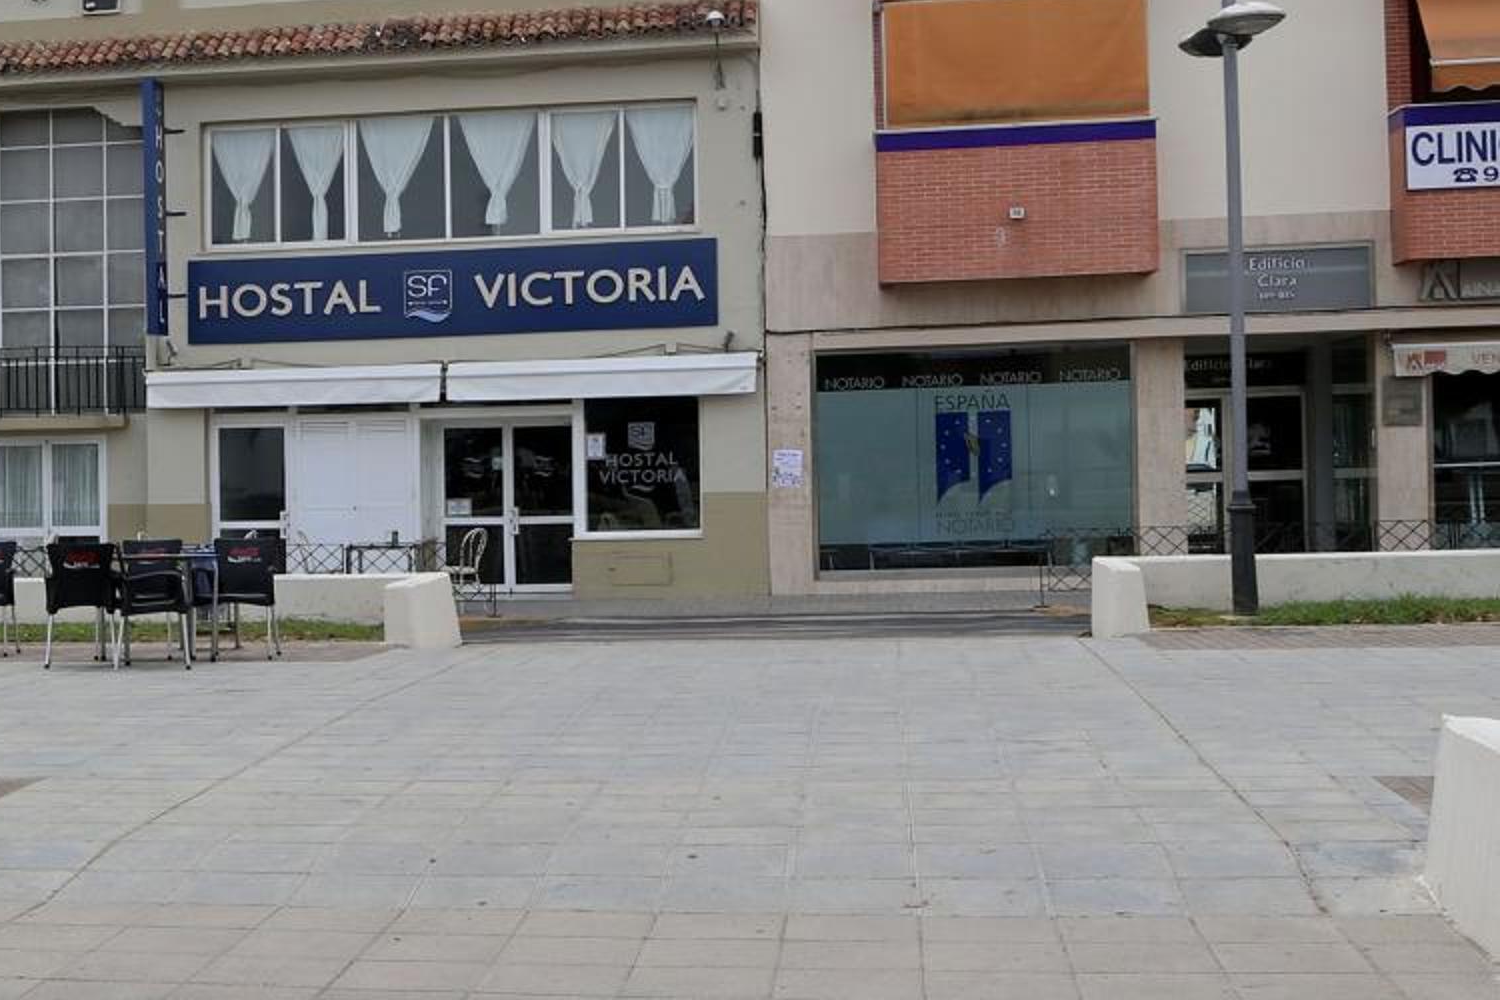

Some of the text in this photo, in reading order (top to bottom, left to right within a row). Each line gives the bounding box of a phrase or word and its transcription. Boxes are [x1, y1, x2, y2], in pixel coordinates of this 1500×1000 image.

[1411, 130, 1500, 167] CLINI
[155, 124, 165, 324] HOSTAL
[408, 274, 447, 298] SF
[474, 265, 706, 309] VICTORIA
[199, 280, 381, 319] HOSTAL
[825, 367, 1121, 391] NOTARIO NOTARIO NOTARIO NOTARIO
[935, 389, 1011, 410] ESPAÑA
[605, 451, 678, 467] HOSTAL
[599, 467, 685, 484] VICTORIA
